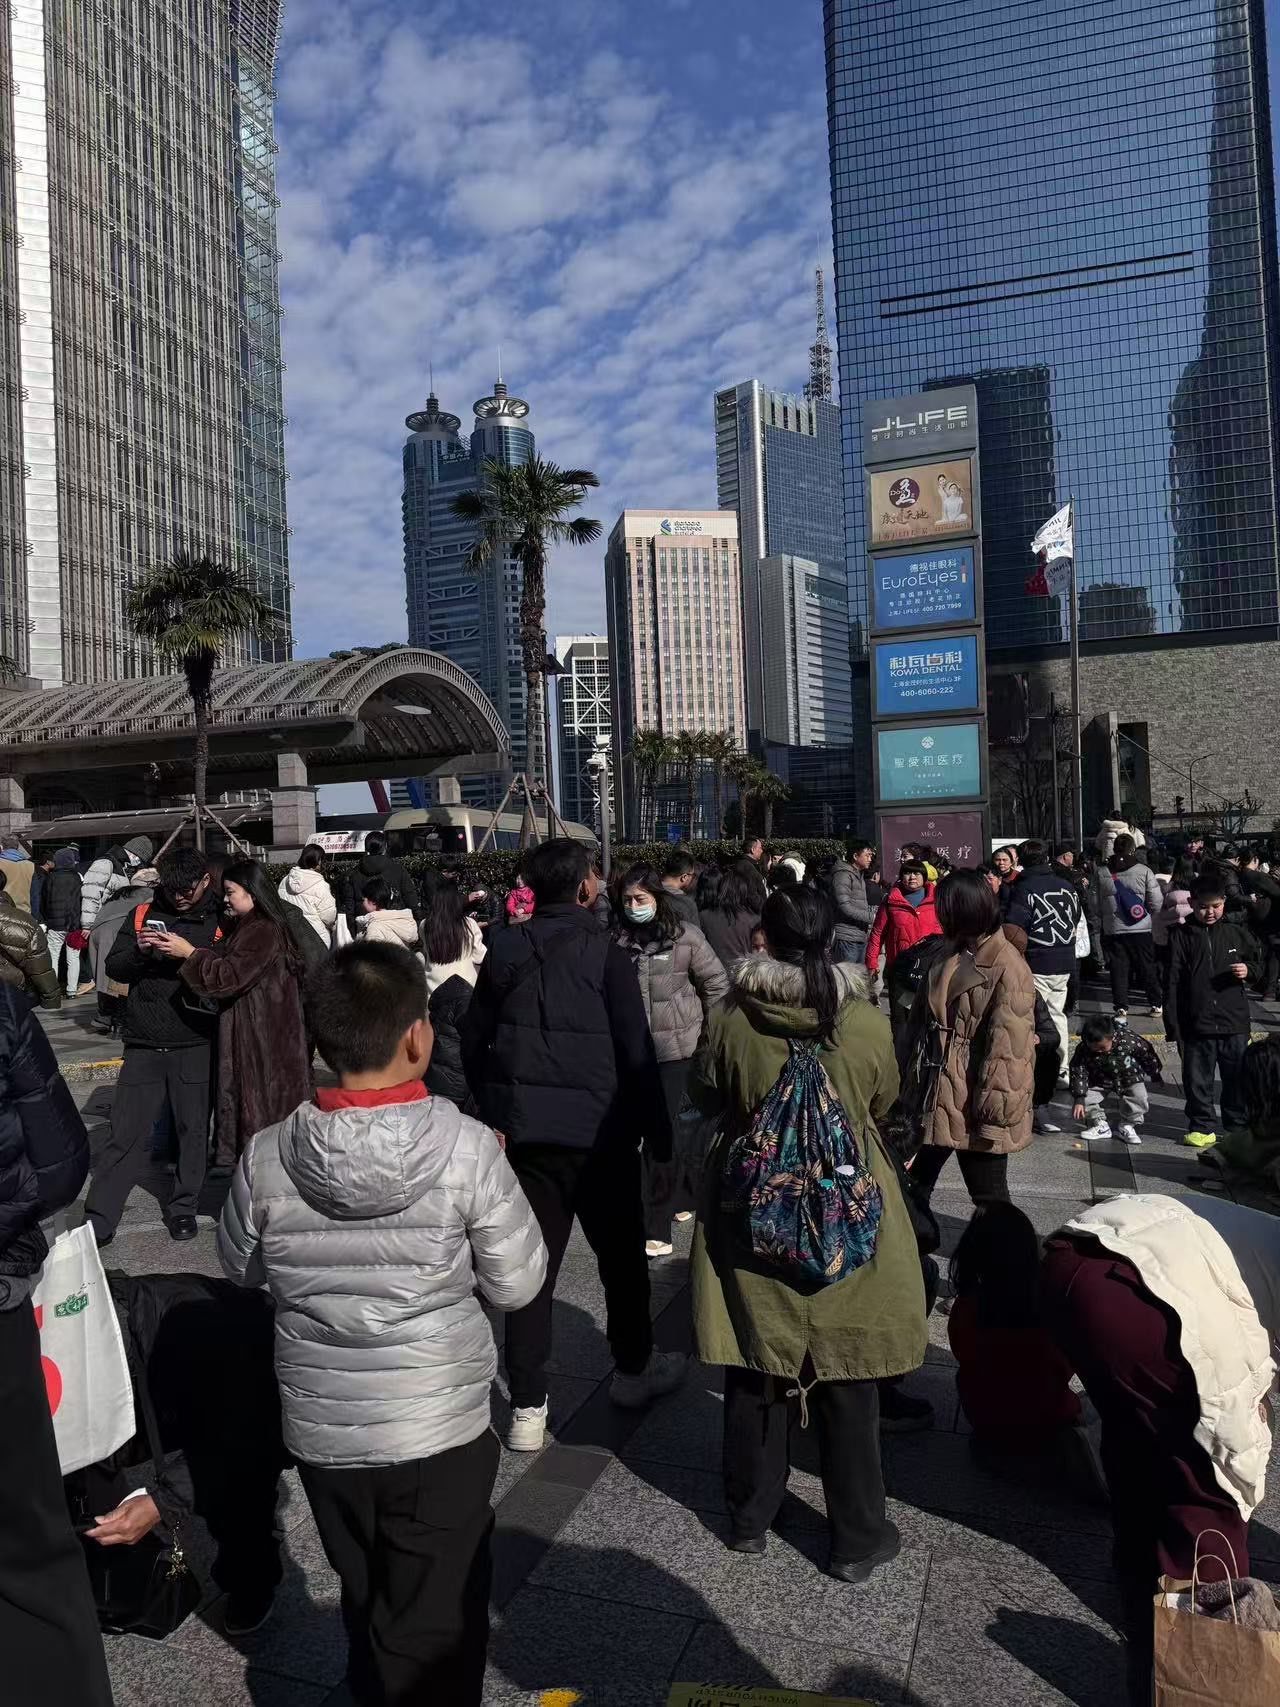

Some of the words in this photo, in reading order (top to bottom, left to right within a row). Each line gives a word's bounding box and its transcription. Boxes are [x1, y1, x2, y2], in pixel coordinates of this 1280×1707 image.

[882, 571, 958, 590] EuroEyes
[890, 668, 920, 677] KOWA
[921, 664, 962, 674] DENTAL
